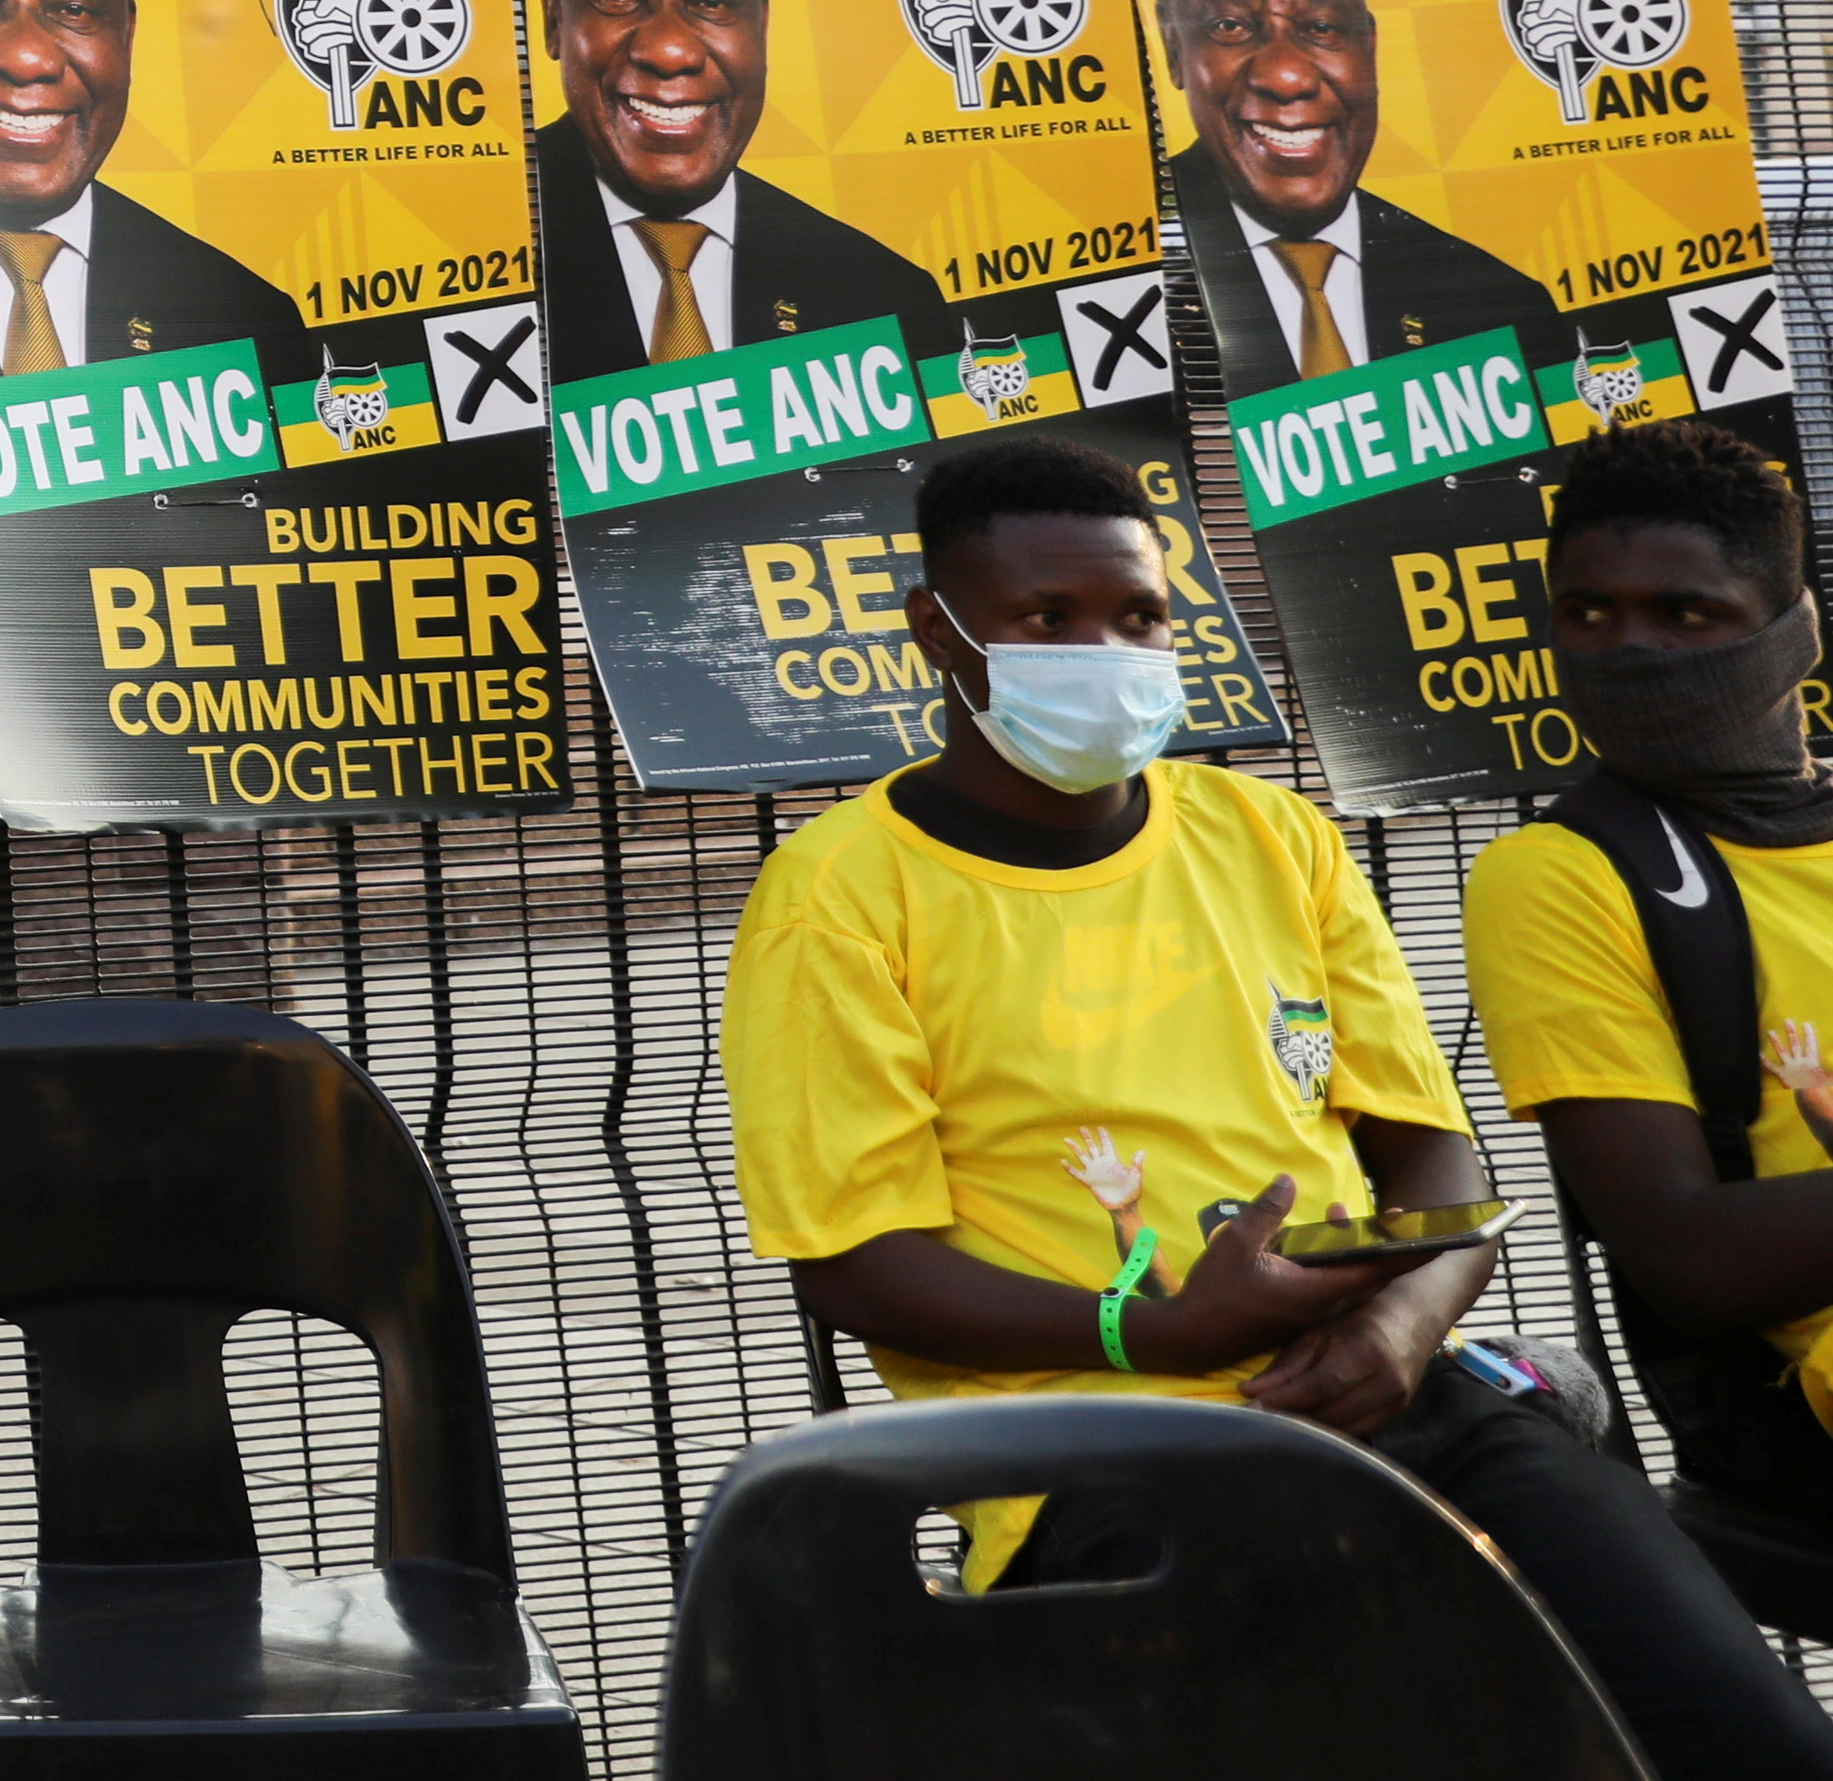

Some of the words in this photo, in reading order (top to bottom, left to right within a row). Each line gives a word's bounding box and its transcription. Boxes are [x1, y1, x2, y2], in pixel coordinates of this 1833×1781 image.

[365, 77, 485, 129] ANC
[991, 55, 1106, 108] ANC
[1596, 67, 1708, 121] ANC
[273, 151, 285, 163] A
[292, 148, 368, 163] BETTER
[375, 146, 417, 160] LIFE
[425, 144, 464, 158] FOR
[472, 143, 509, 156] ALL
[905, 132, 917, 144] A
[923, 127, 995, 143] BETTER
[1002, 124, 1042, 138] LIFE
[1049, 120, 1087, 135] FOR
[1095, 118, 1131, 131] ALL
[1514, 148, 1524, 159] A
[1530, 140, 1601, 158] BETTER
[1607, 135, 1646, 150] LIFE
[1653, 130, 1692, 145] FOR
[1699, 127, 1734, 141] ALL
[307, 282, 323, 318] 1
[341, 265, 422, 313] NOV
[438, 246, 528, 297] 2021
[945, 258, 961, 293] 1
[976, 238, 1053, 287] NOV
[1068, 217, 1155, 268] 2021
[1558, 269, 1573, 303] 1
[1587, 247, 1662, 296] NOV
[1678, 223, 1765, 274] 2021
[123, 369, 263, 476] ANC
[560, 378, 755, 493] VOTE
[771, 346, 912, 453] ANC
[999, 394, 1038, 419] ANC
[1237, 392, 1397, 506] VOTE
[1403, 356, 1534, 466] ANC
[1610, 399, 1654, 423] ANC
[354, 426, 395, 449] ANC
[265, 499, 536, 553] BUILDING
[89, 556, 547, 669] BETTER
[109, 667, 549, 735] COMMUNITIES
[187, 732, 558, 804] TOGETHER
